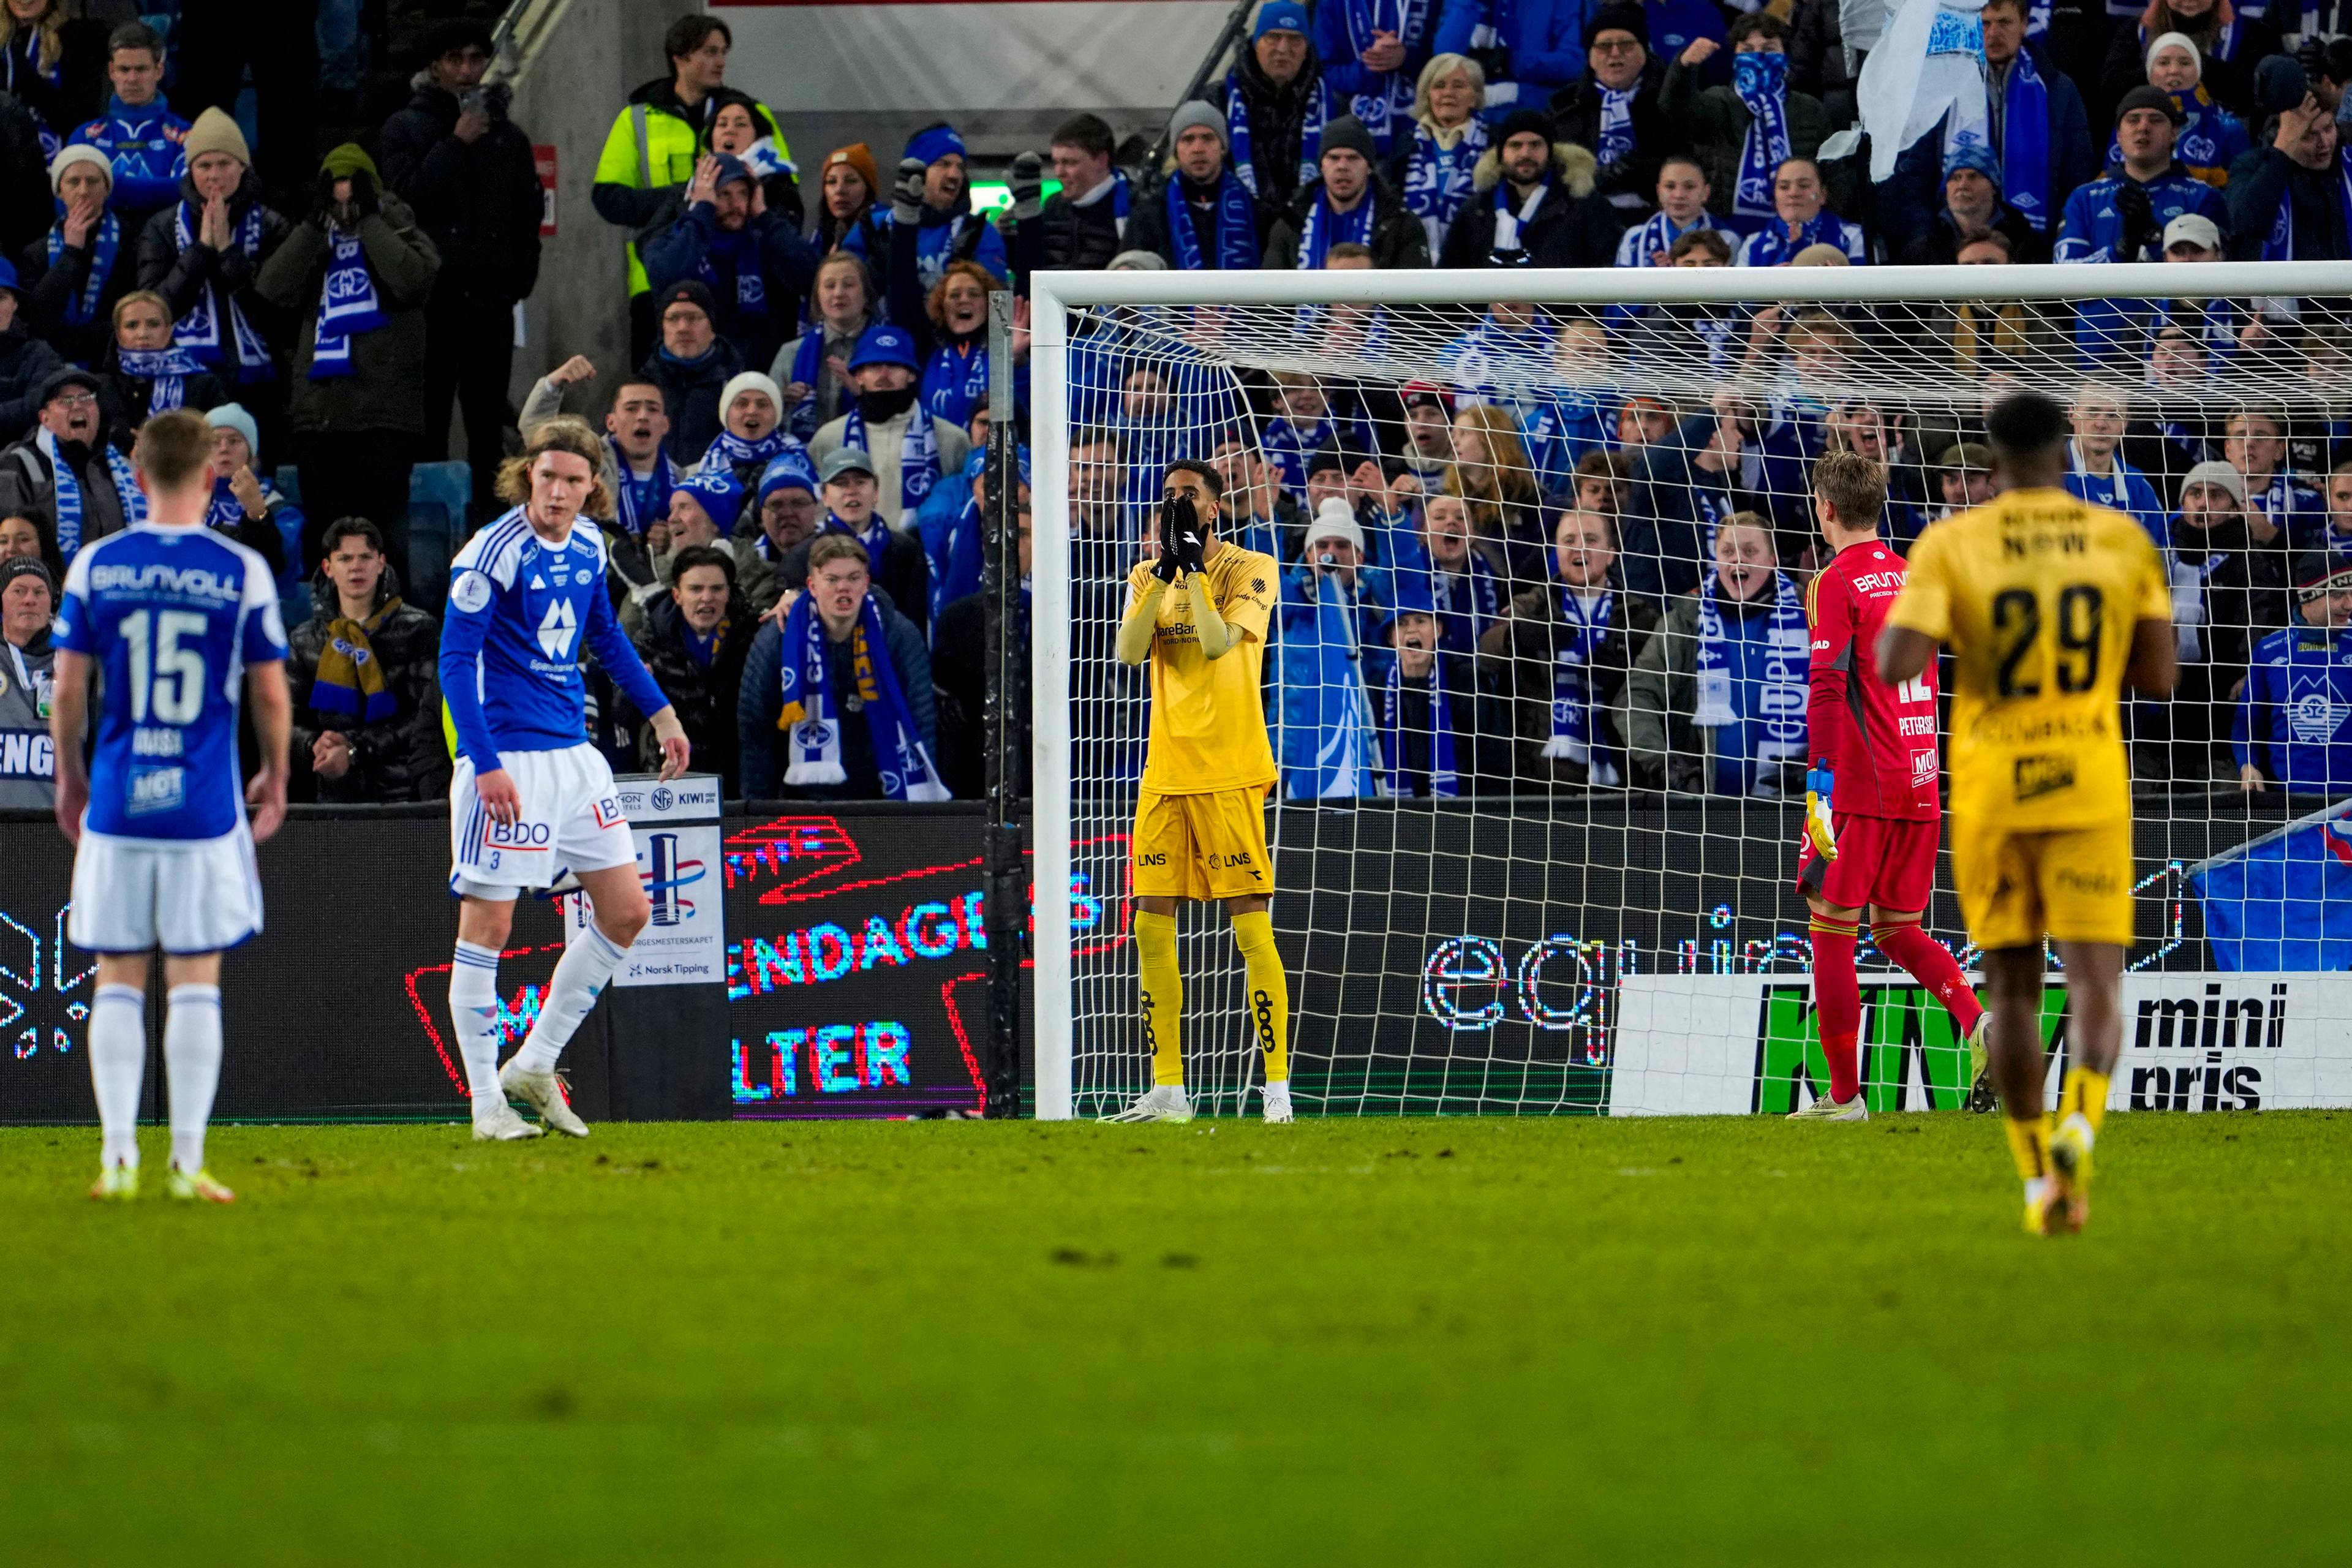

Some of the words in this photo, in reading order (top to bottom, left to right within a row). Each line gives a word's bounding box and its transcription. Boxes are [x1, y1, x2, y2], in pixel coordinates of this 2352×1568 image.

[90, 564, 241, 601] BRUNVOLL
[1992, 584, 2104, 698] 29
[119, 608, 208, 725] 15
[1915, 750, 1936, 774] MOT
[679, 793, 704, 805] KIWI
[494, 823, 549, 845] BDO
[490, 851, 499, 870] 3
[1139, 853, 1166, 866] LNS
[1224, 852, 1251, 867] LNS
[646, 964, 673, 974] Norsk
[674, 962, 709, 976] Tipping
[1254, 989, 1276, 1054] coop
[2135, 983, 2287, 1048] mini
[2130, 1051, 2261, 1111] pris
